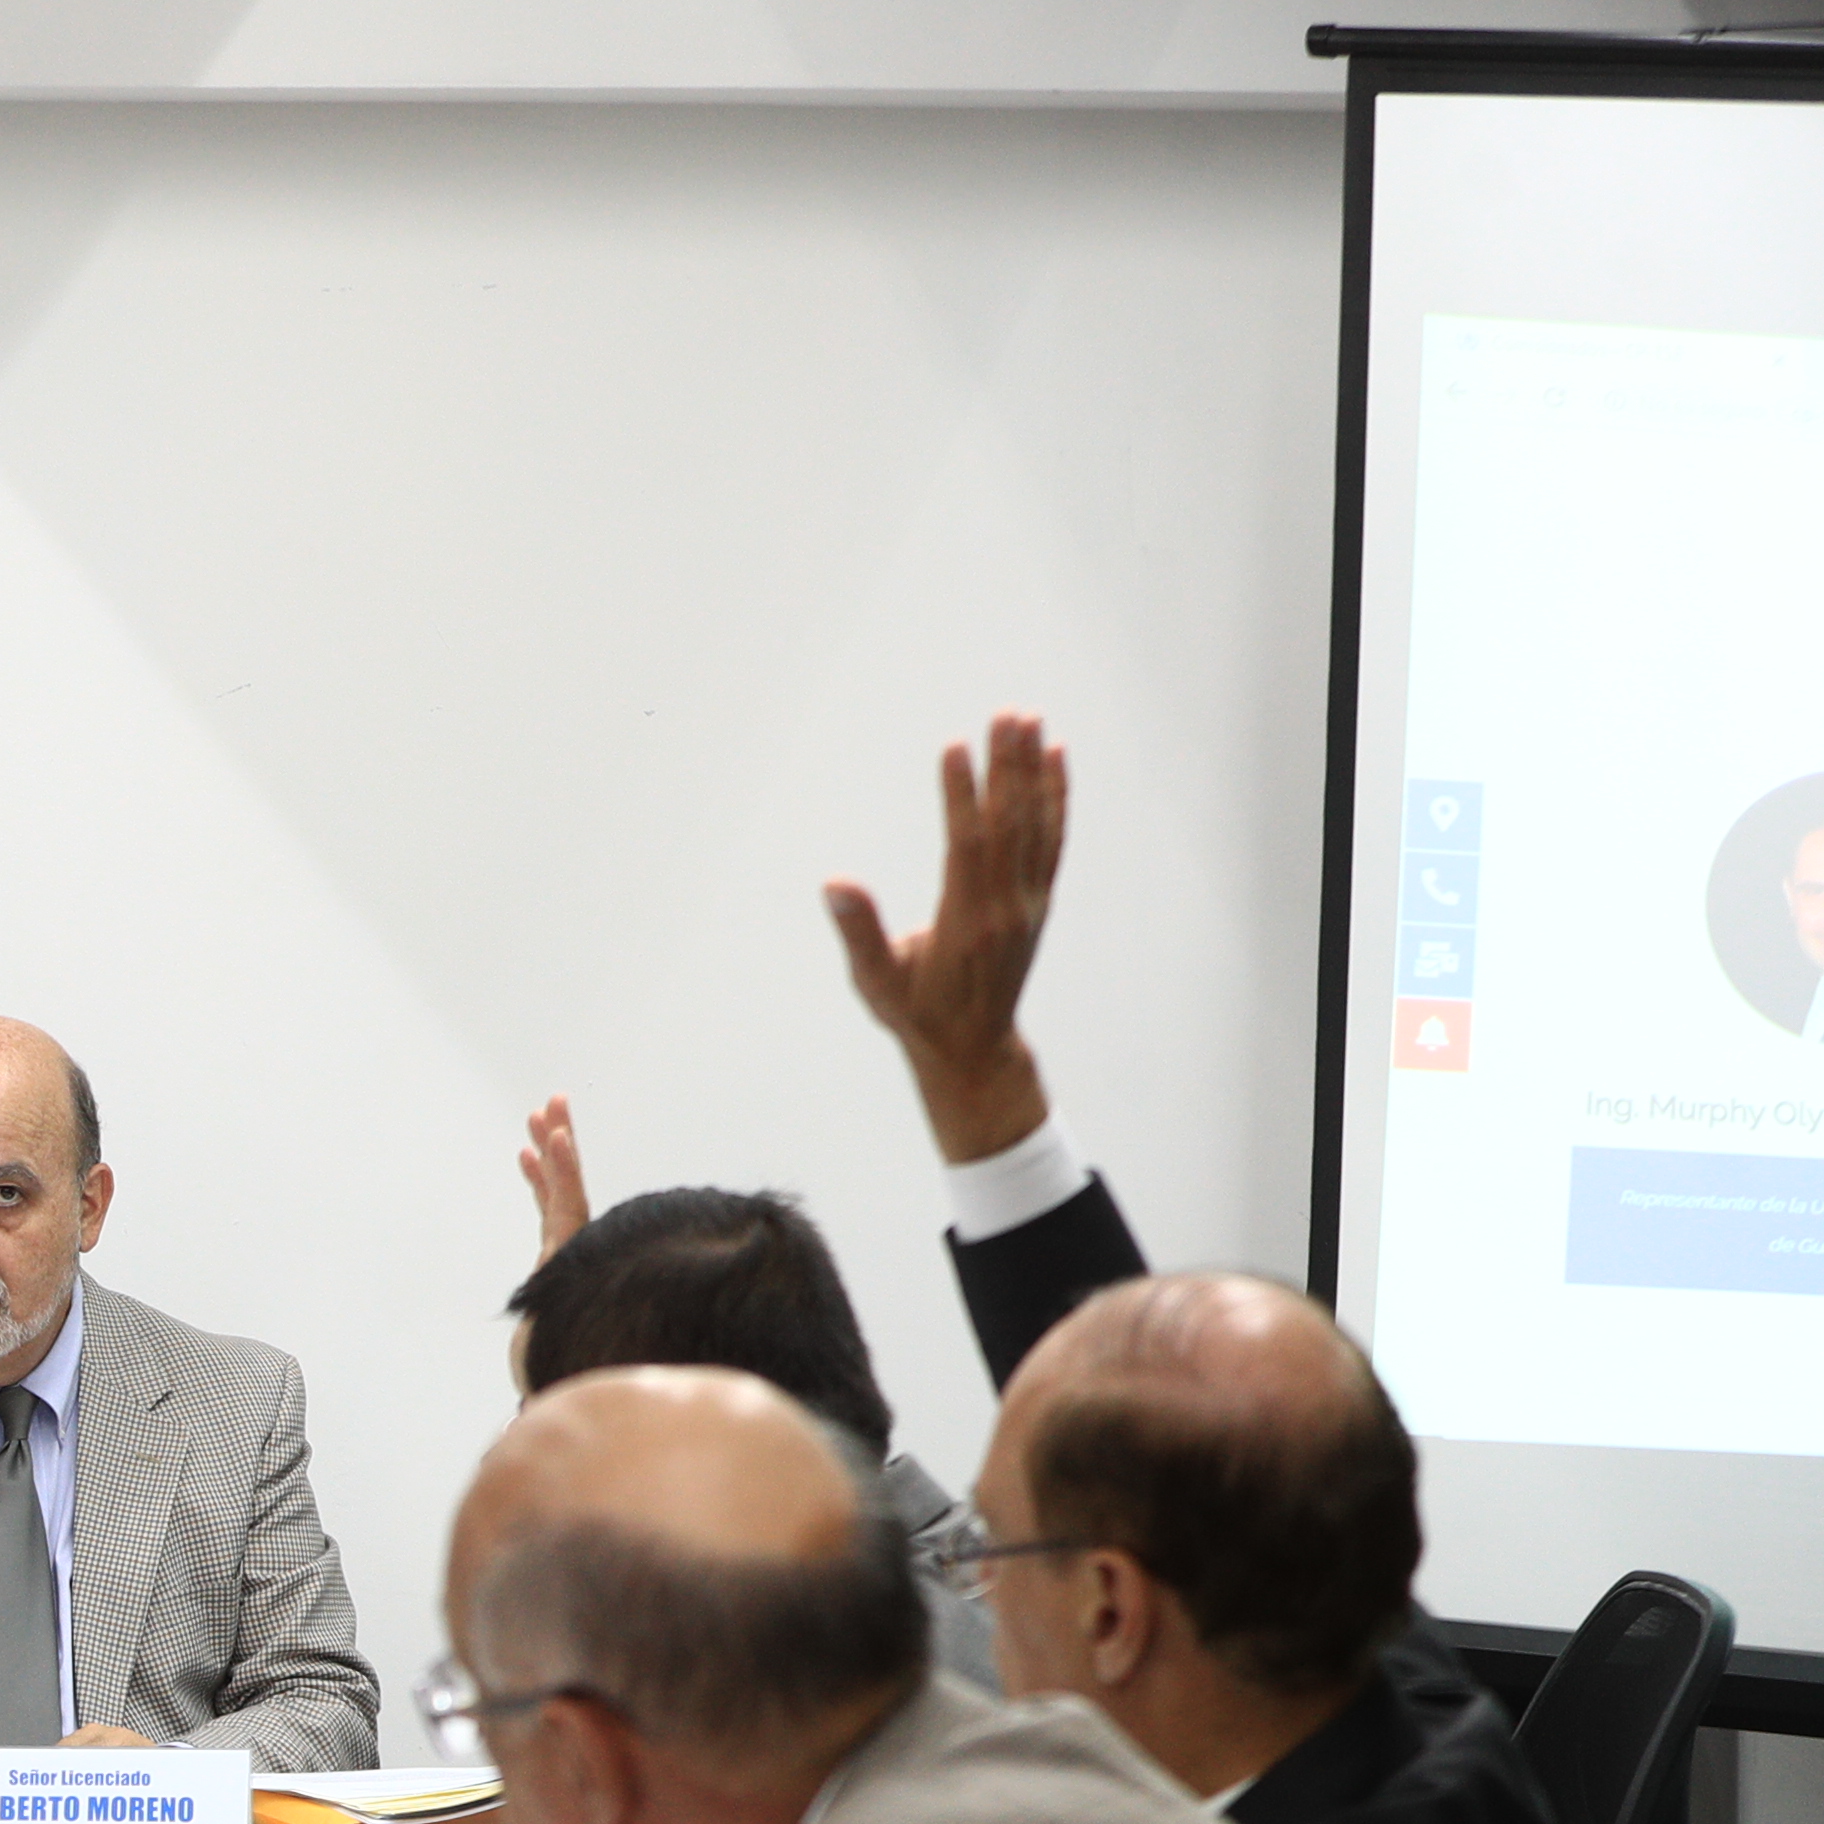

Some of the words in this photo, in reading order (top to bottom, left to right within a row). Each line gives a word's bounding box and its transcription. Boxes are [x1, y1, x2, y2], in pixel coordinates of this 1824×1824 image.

[1586, 1091, 1639, 1125] Ing.
[1649, 1094, 1766, 1131] Murphy
[1619, 1189, 1757, 1212] Representante
[1758, 1195, 1787, 1213] de
[1788, 1197, 1807, 1215] la
[1768, 1235, 1796, 1254] de
[8, 1769, 58, 1786] Señor
[61, 1770, 151, 1787] Licenciado
[87, 1796, 195, 1823] MORENO
